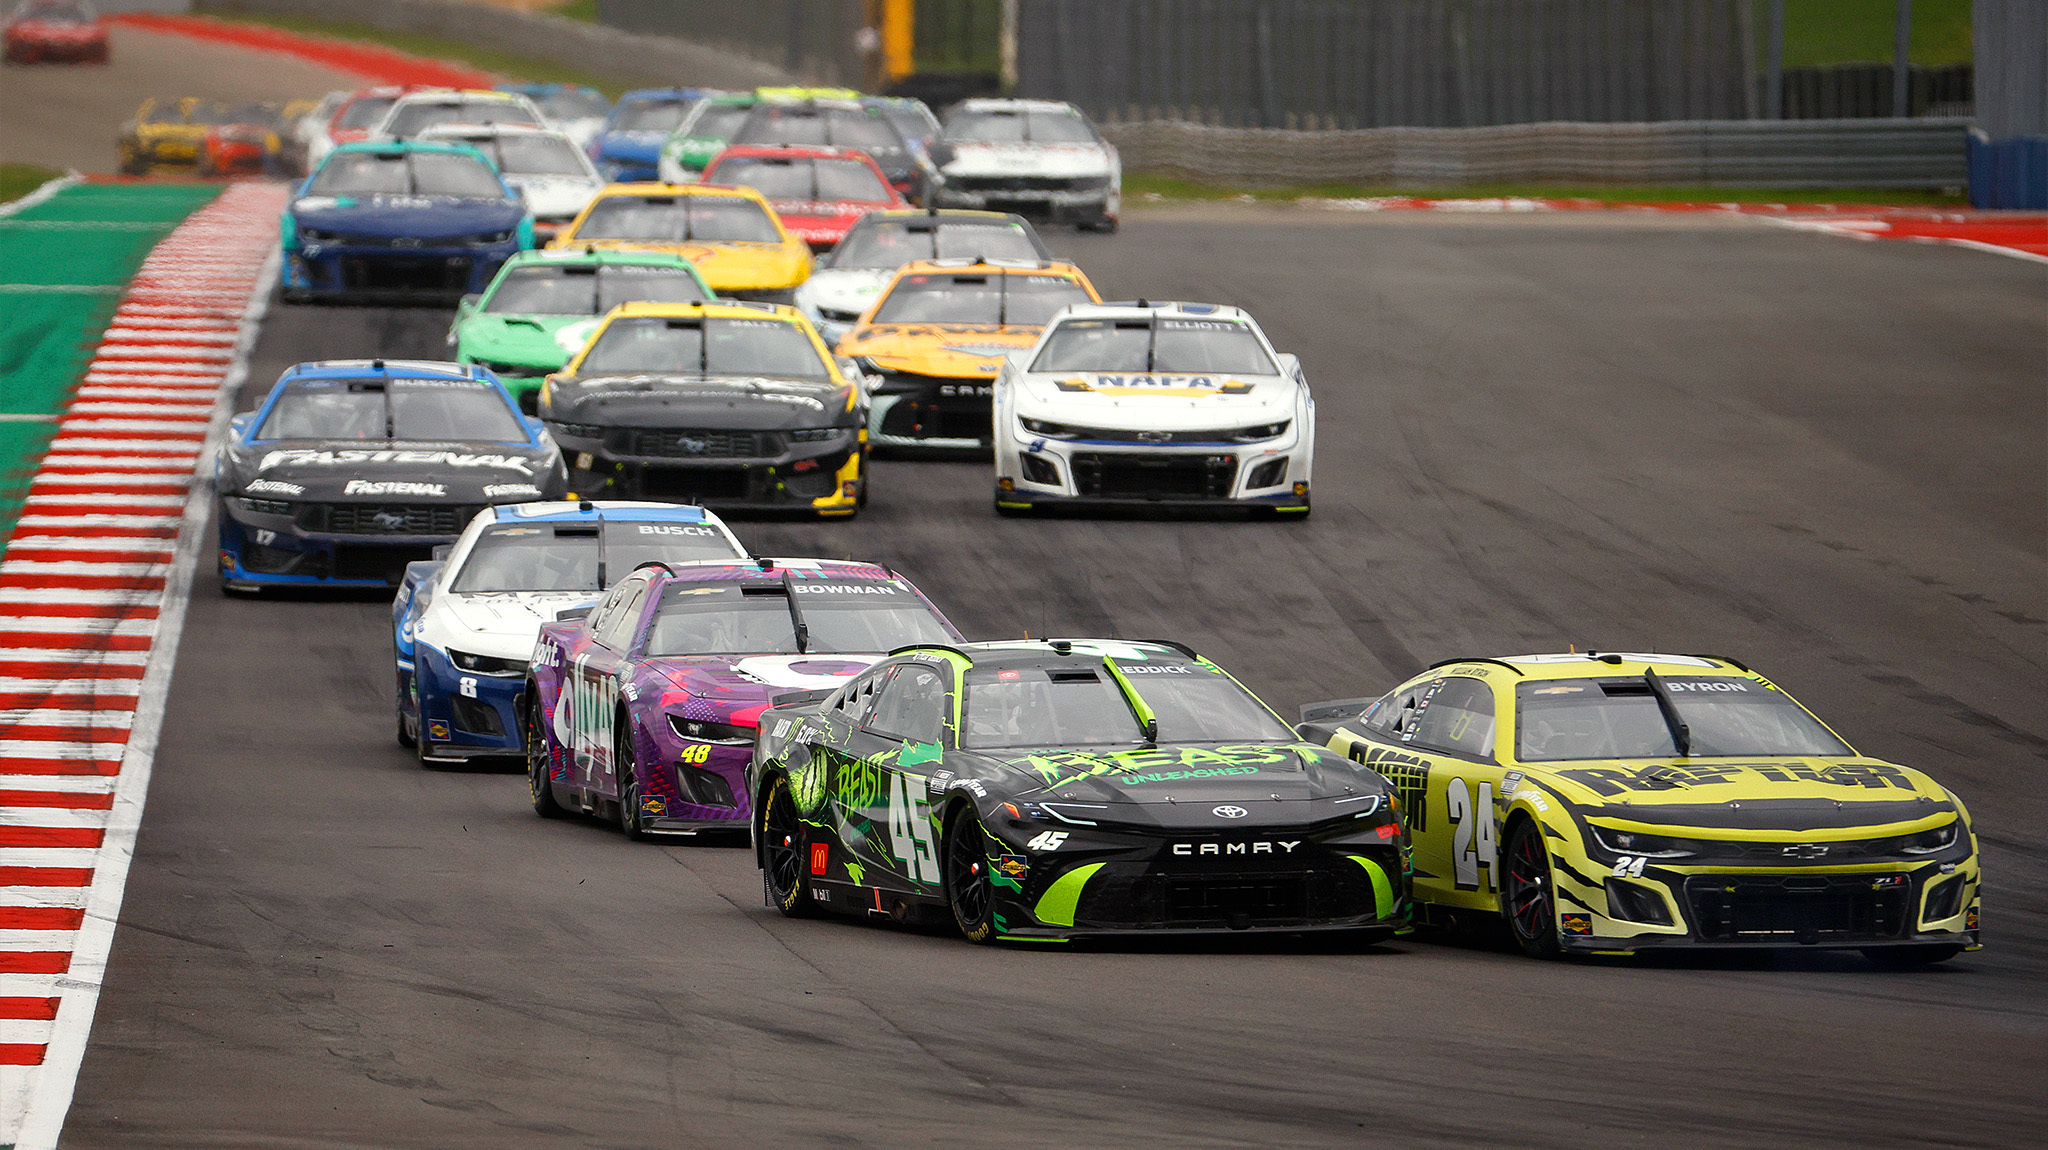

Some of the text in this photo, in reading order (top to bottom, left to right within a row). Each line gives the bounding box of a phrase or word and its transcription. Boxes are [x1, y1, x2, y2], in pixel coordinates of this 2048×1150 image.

[1164, 320, 1233, 331] ELLIOTT
[1097, 374, 1215, 388] NAPA
[258, 448, 534, 477] FASTENAL
[245, 479, 305, 496] FASTENAL
[343, 479, 448, 497] FASTENAL
[482, 483, 543, 498] FASTENAL
[255, 529, 277, 546] 17
[639, 525, 716, 538] BUSCH
[795, 583, 896, 596] BOWMAN
[458, 676, 479, 699] 8
[1667, 682, 1748, 694] BYRON
[681, 744, 711, 764] 48
[994, 744, 1328, 793] BEAST
[1121, 766, 1260, 786] UNLEASHED
[833, 748, 901, 830] BEAST
[1555, 762, 1917, 797] RAPTOR
[888, 770, 941, 887] 45
[1447, 777, 1499, 893] 24
[1026, 830, 1070, 852] 45
[1172, 840, 1301, 857] CAMRY
[1611, 857, 1649, 879] 24
